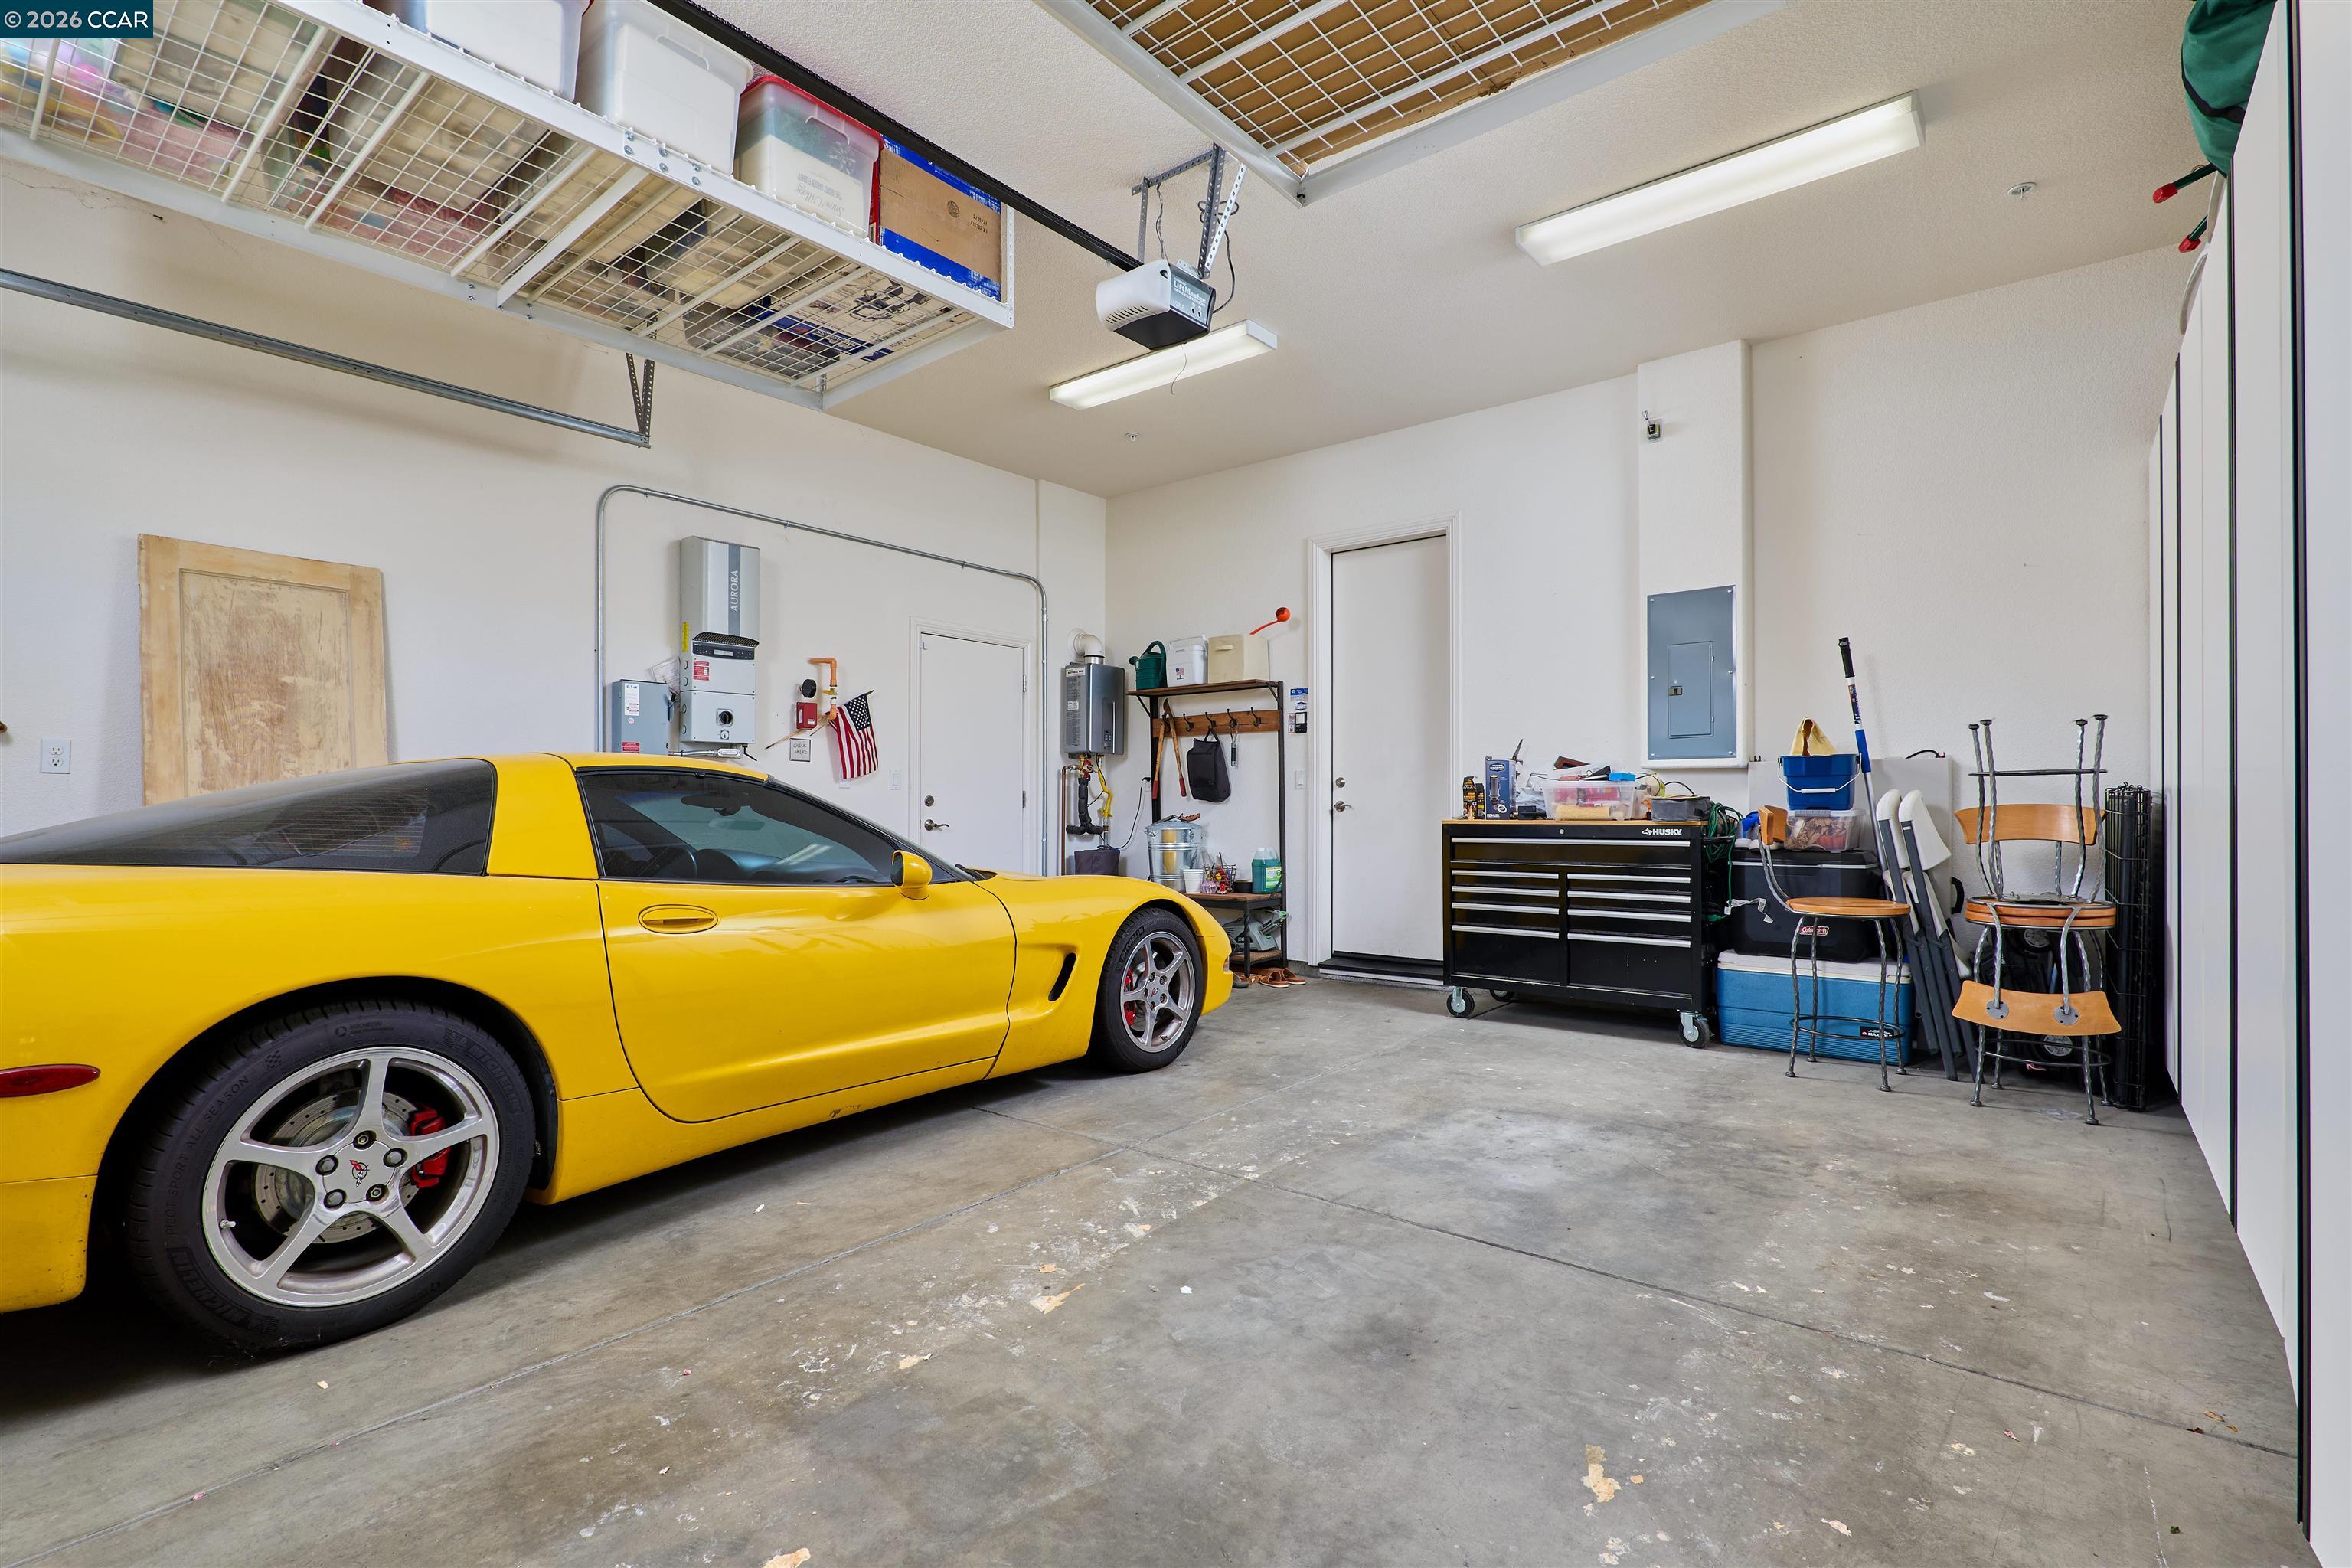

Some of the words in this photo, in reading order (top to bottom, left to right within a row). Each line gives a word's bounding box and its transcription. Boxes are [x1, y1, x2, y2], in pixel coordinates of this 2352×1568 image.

[1173, 279, 1207, 303] LiftMaster
[730, 570, 739, 612] AURORA
[1120, 926, 1145, 961] MICHELIN
[466, 1044, 523, 1113] MICHELIN
[203, 1075, 249, 1122] SEASON
[186, 1126, 206, 1151] ALL
[168, 1153, 189, 1196] SPORT
[165, 1202, 178, 1236] PILOT
